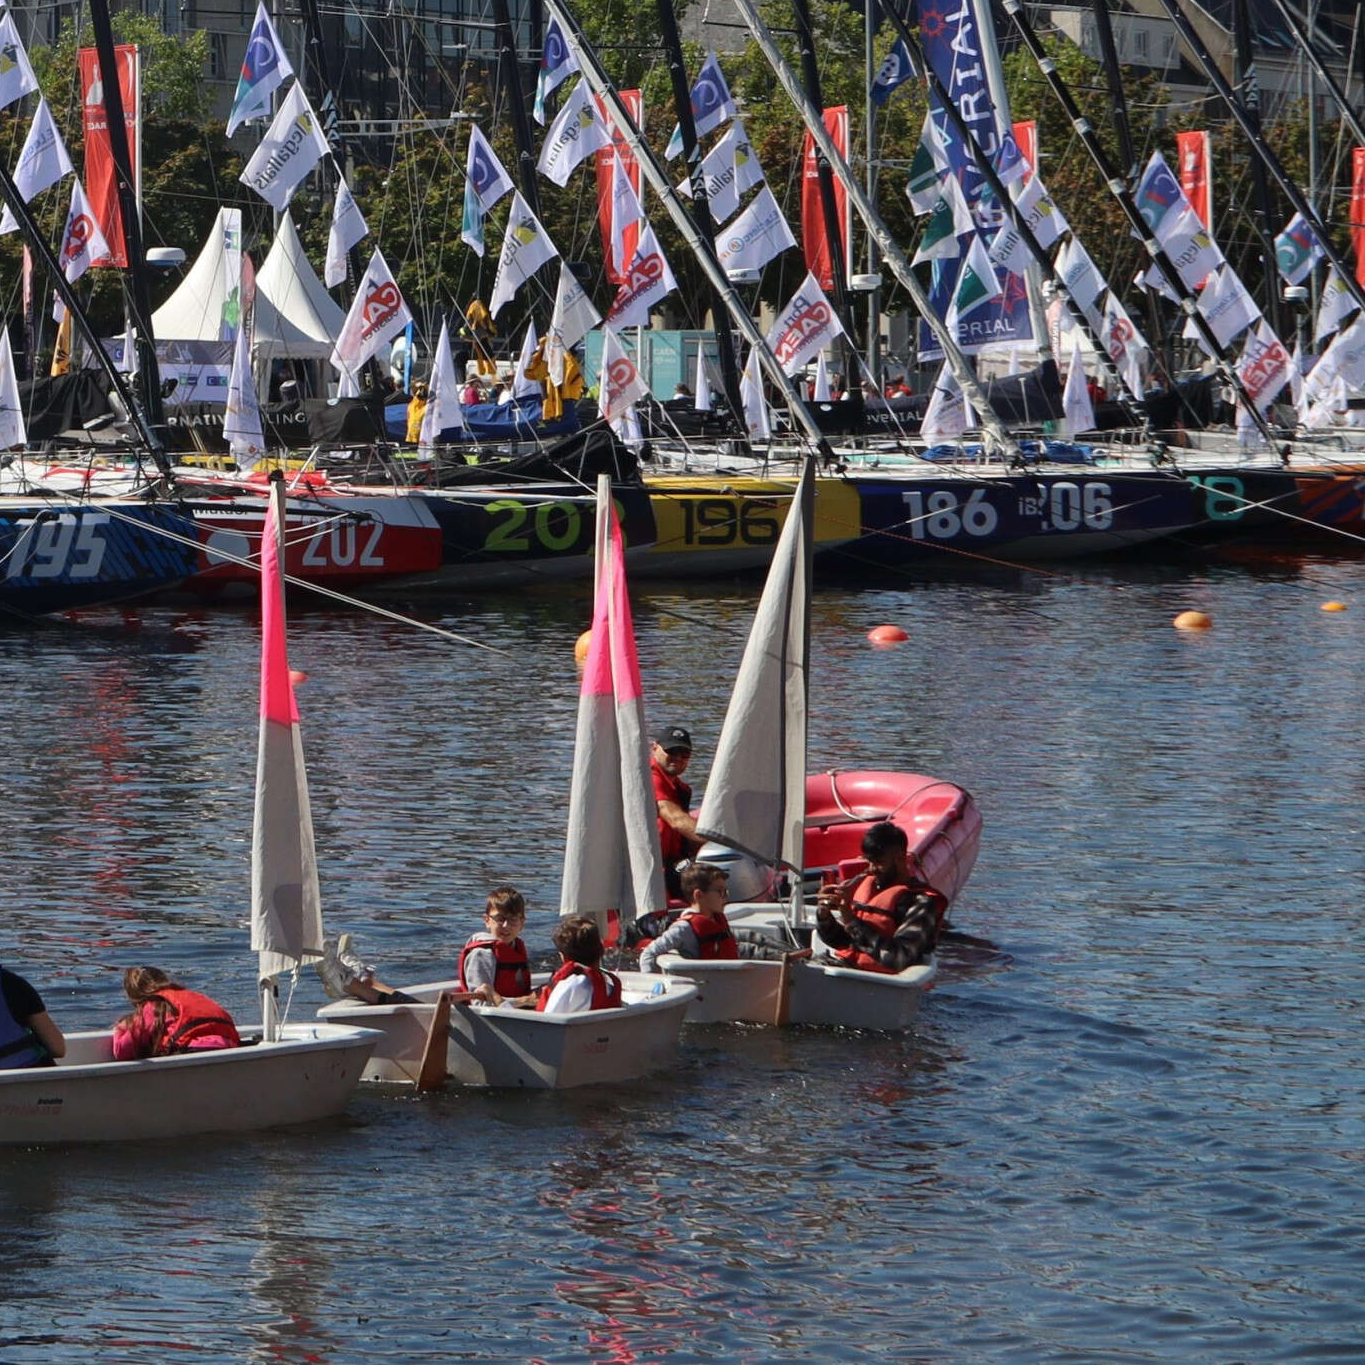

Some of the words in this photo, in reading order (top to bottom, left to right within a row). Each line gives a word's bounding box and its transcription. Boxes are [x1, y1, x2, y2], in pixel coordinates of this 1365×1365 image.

[302, 512, 385, 566] 202
[680, 499, 778, 545] 196
[902, 489, 999, 539] 186
[7, 514, 110, 578] 195
